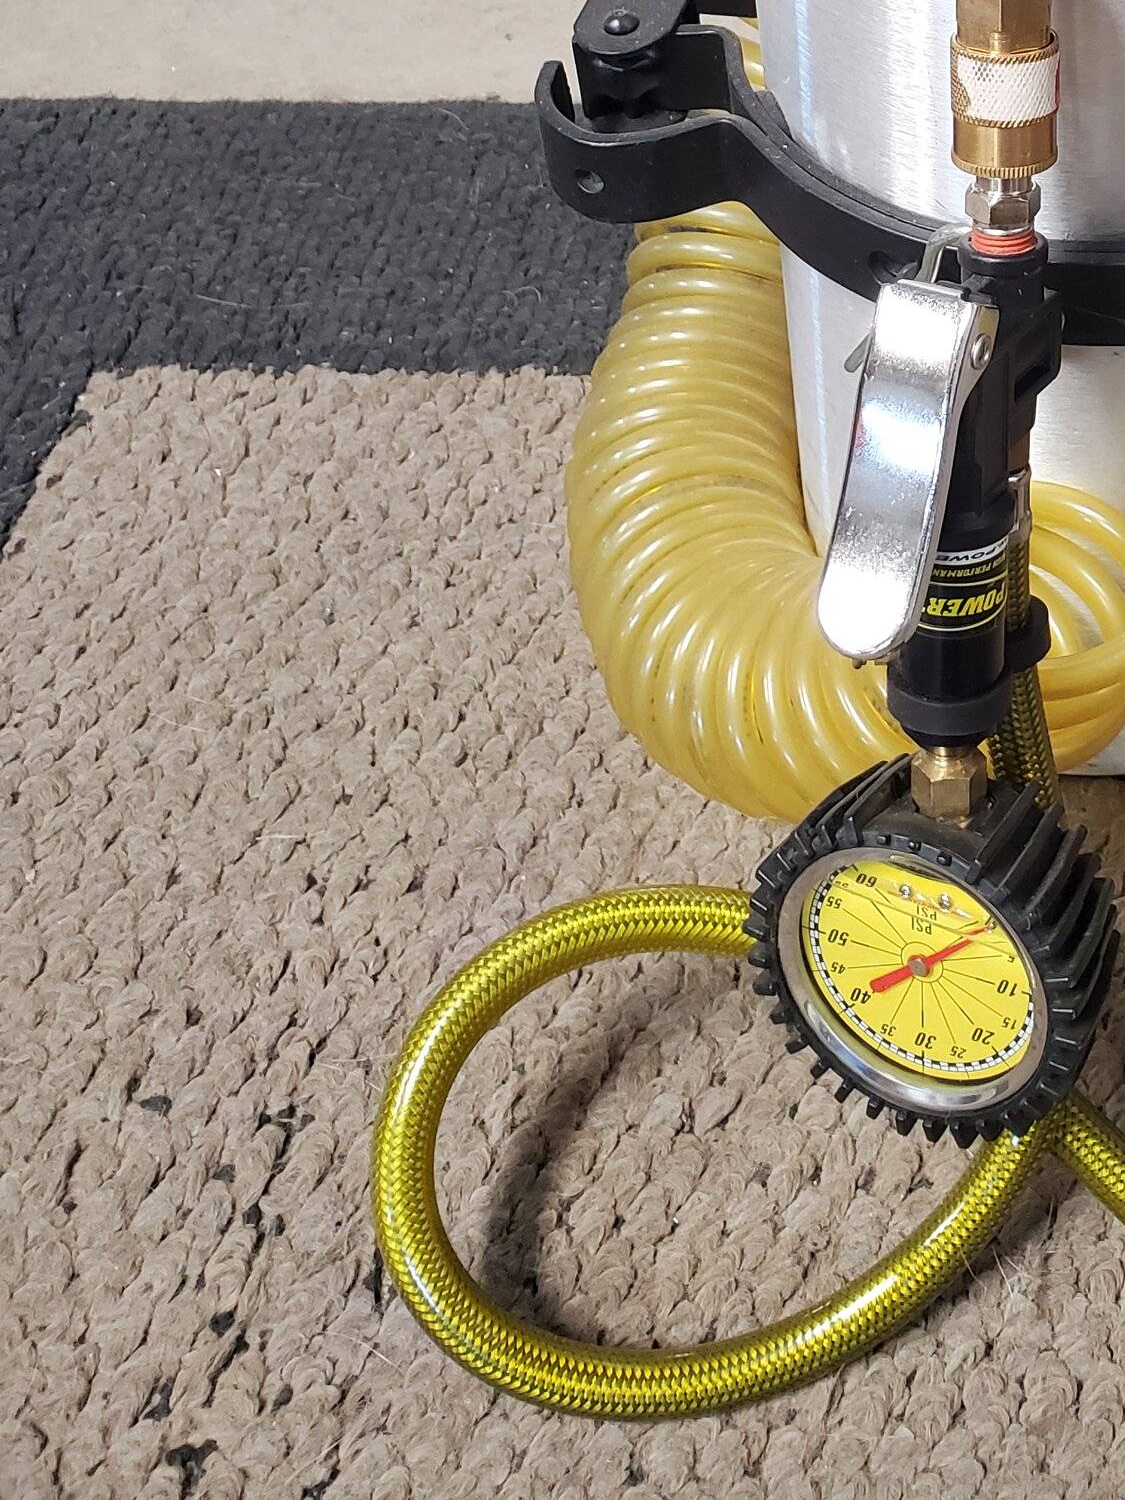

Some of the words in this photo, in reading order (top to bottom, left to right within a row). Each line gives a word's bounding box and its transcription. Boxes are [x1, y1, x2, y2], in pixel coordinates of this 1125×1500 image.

[932, 562, 992, 578] PERFORMAN
[924, 580, 1005, 617] POWER
[856, 872, 878, 888] 60
[825, 895, 843, 910] 55
[911, 916, 933, 935] PSI
[828, 928, 849, 946] 50
[830, 961, 846, 974] 45
[849, 987, 872, 1005] 40
[996, 979, 1018, 998] 10
[880, 1022, 897, 1038] 35
[1001, 1016, 1018, 1031] 15
[914, 1031, 937, 1049] 30
[971, 1026, 995, 1046] 20
[950, 1042, 967, 1059] 25
